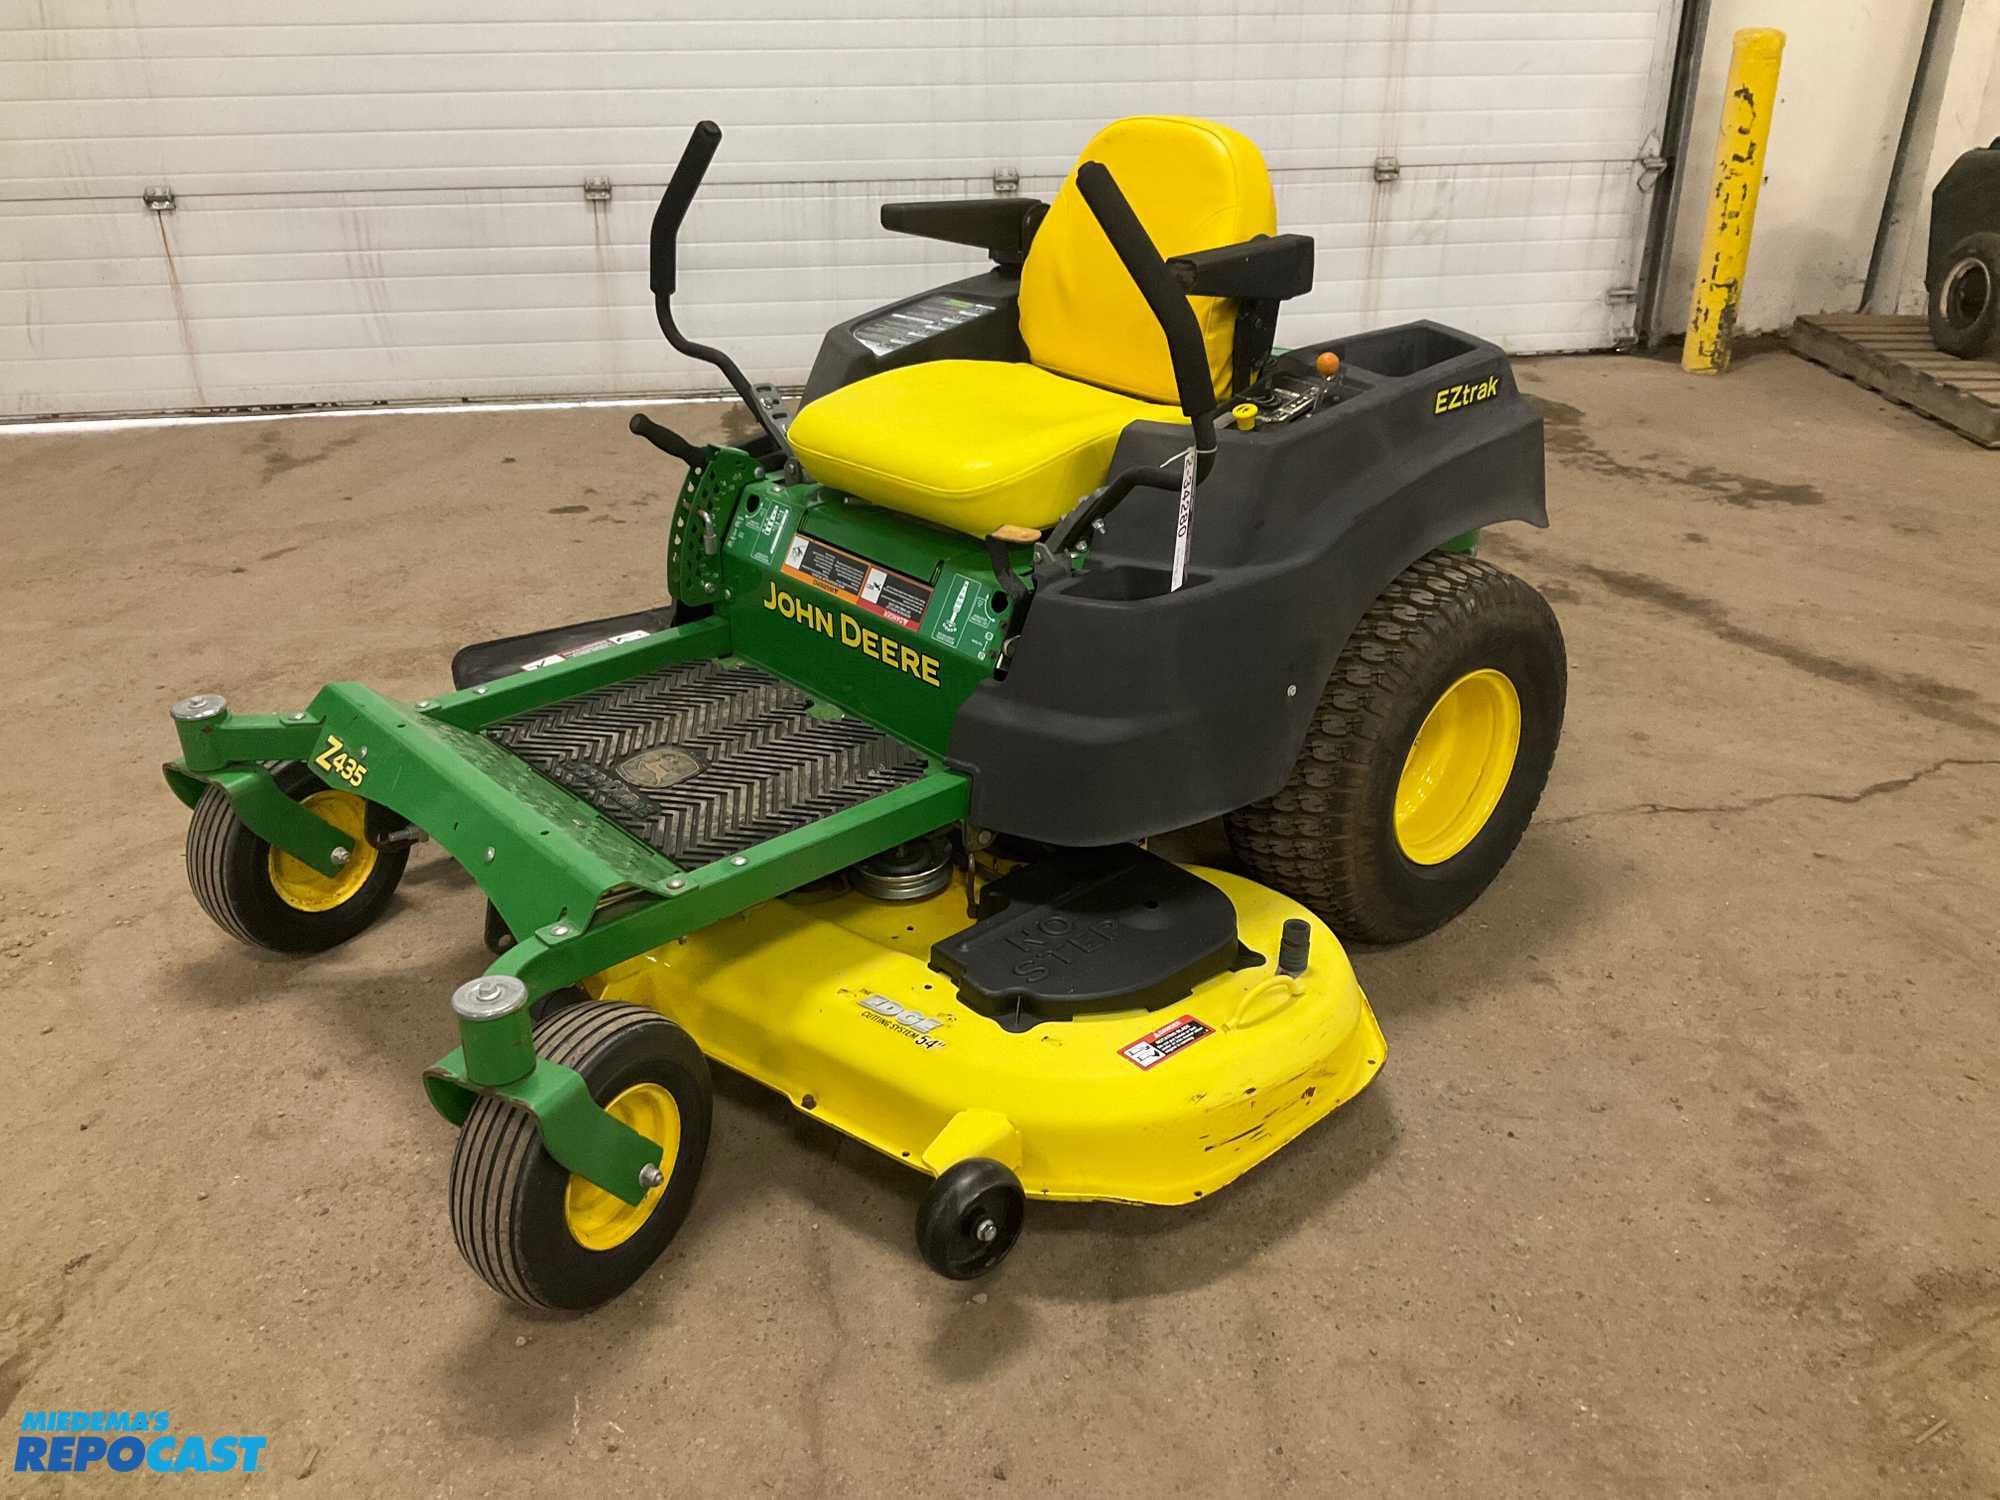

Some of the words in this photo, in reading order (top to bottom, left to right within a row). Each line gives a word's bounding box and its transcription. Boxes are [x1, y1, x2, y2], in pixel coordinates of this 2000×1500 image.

[1434, 375, 1500, 415] EZtrak
[763, 581, 834, 639] JOHN
[840, 612, 942, 688] DEERE
[315, 734, 369, 788] Z435
[1012, 919, 1118, 984] STEP
